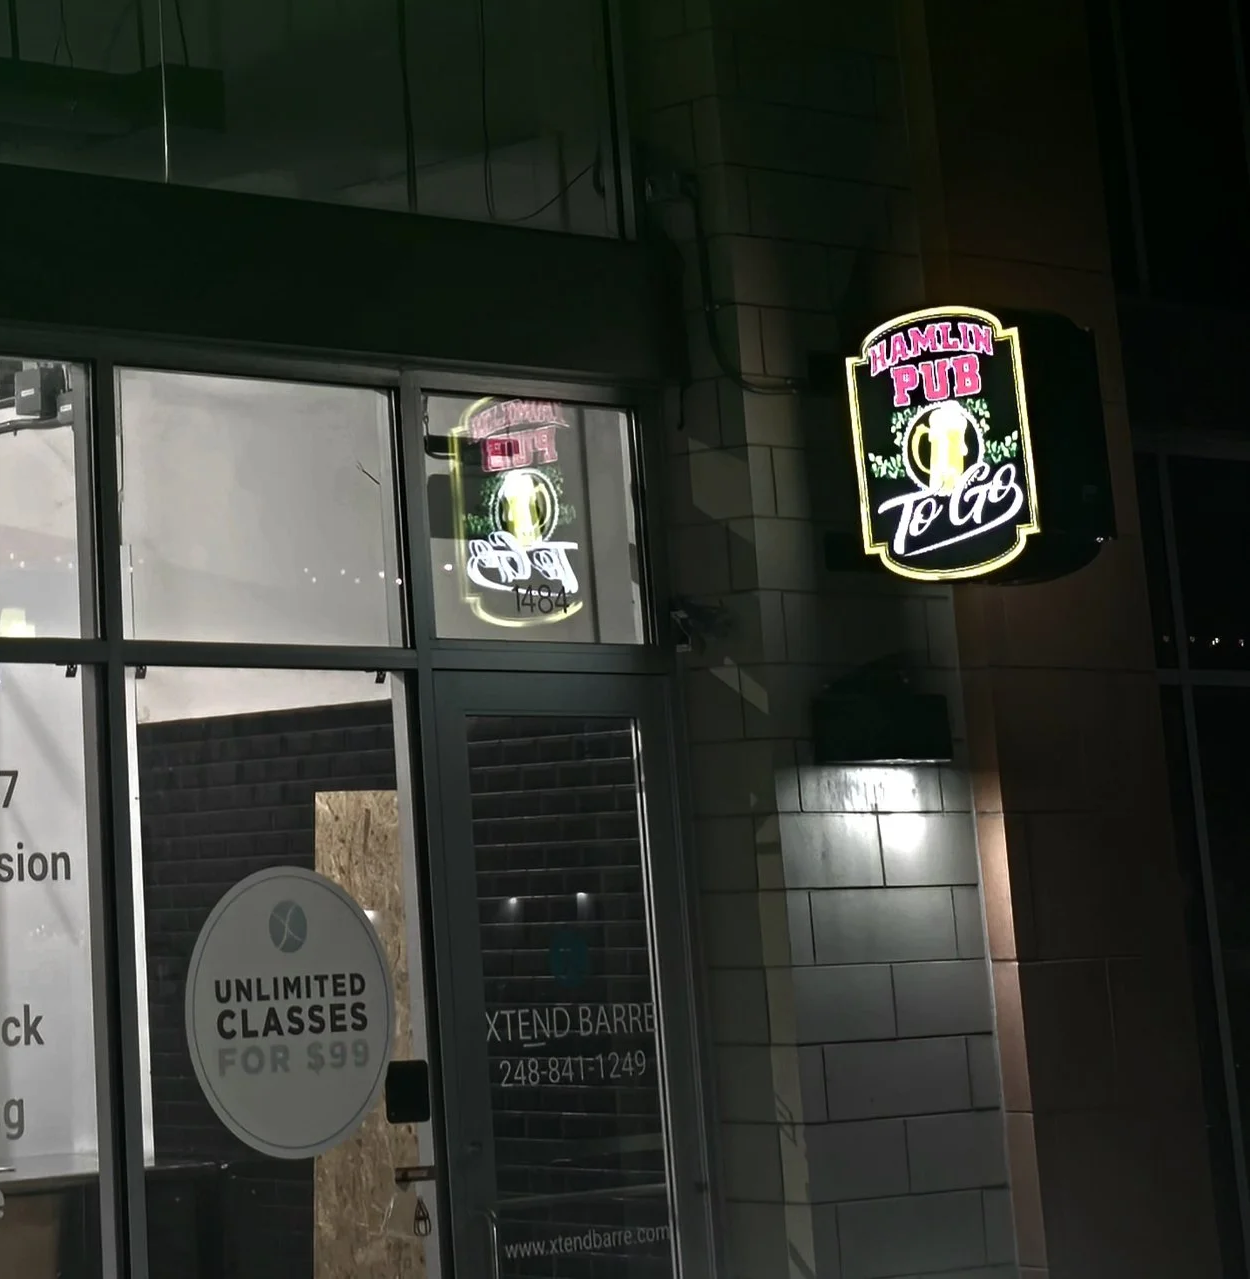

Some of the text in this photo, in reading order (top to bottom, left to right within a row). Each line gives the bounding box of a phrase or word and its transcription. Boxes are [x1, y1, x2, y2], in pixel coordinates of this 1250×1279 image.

[867, 321, 994, 376] HAMLIN
[890, 353, 982, 407] PUB
[878, 488, 944, 555] To
[512, 584, 570, 613] 1484
[214, 973, 366, 1004] UNLIMITED
[216, 1002, 368, 1040] CLASSES
[485, 1003, 656, 1042] XTEND BARRE
[217, 1038, 370, 1078] FOR $99
[500, 1049, 647, 1088] 248-841-1249
[504, 1224, 670, 1259] www.xtendbarre.com
